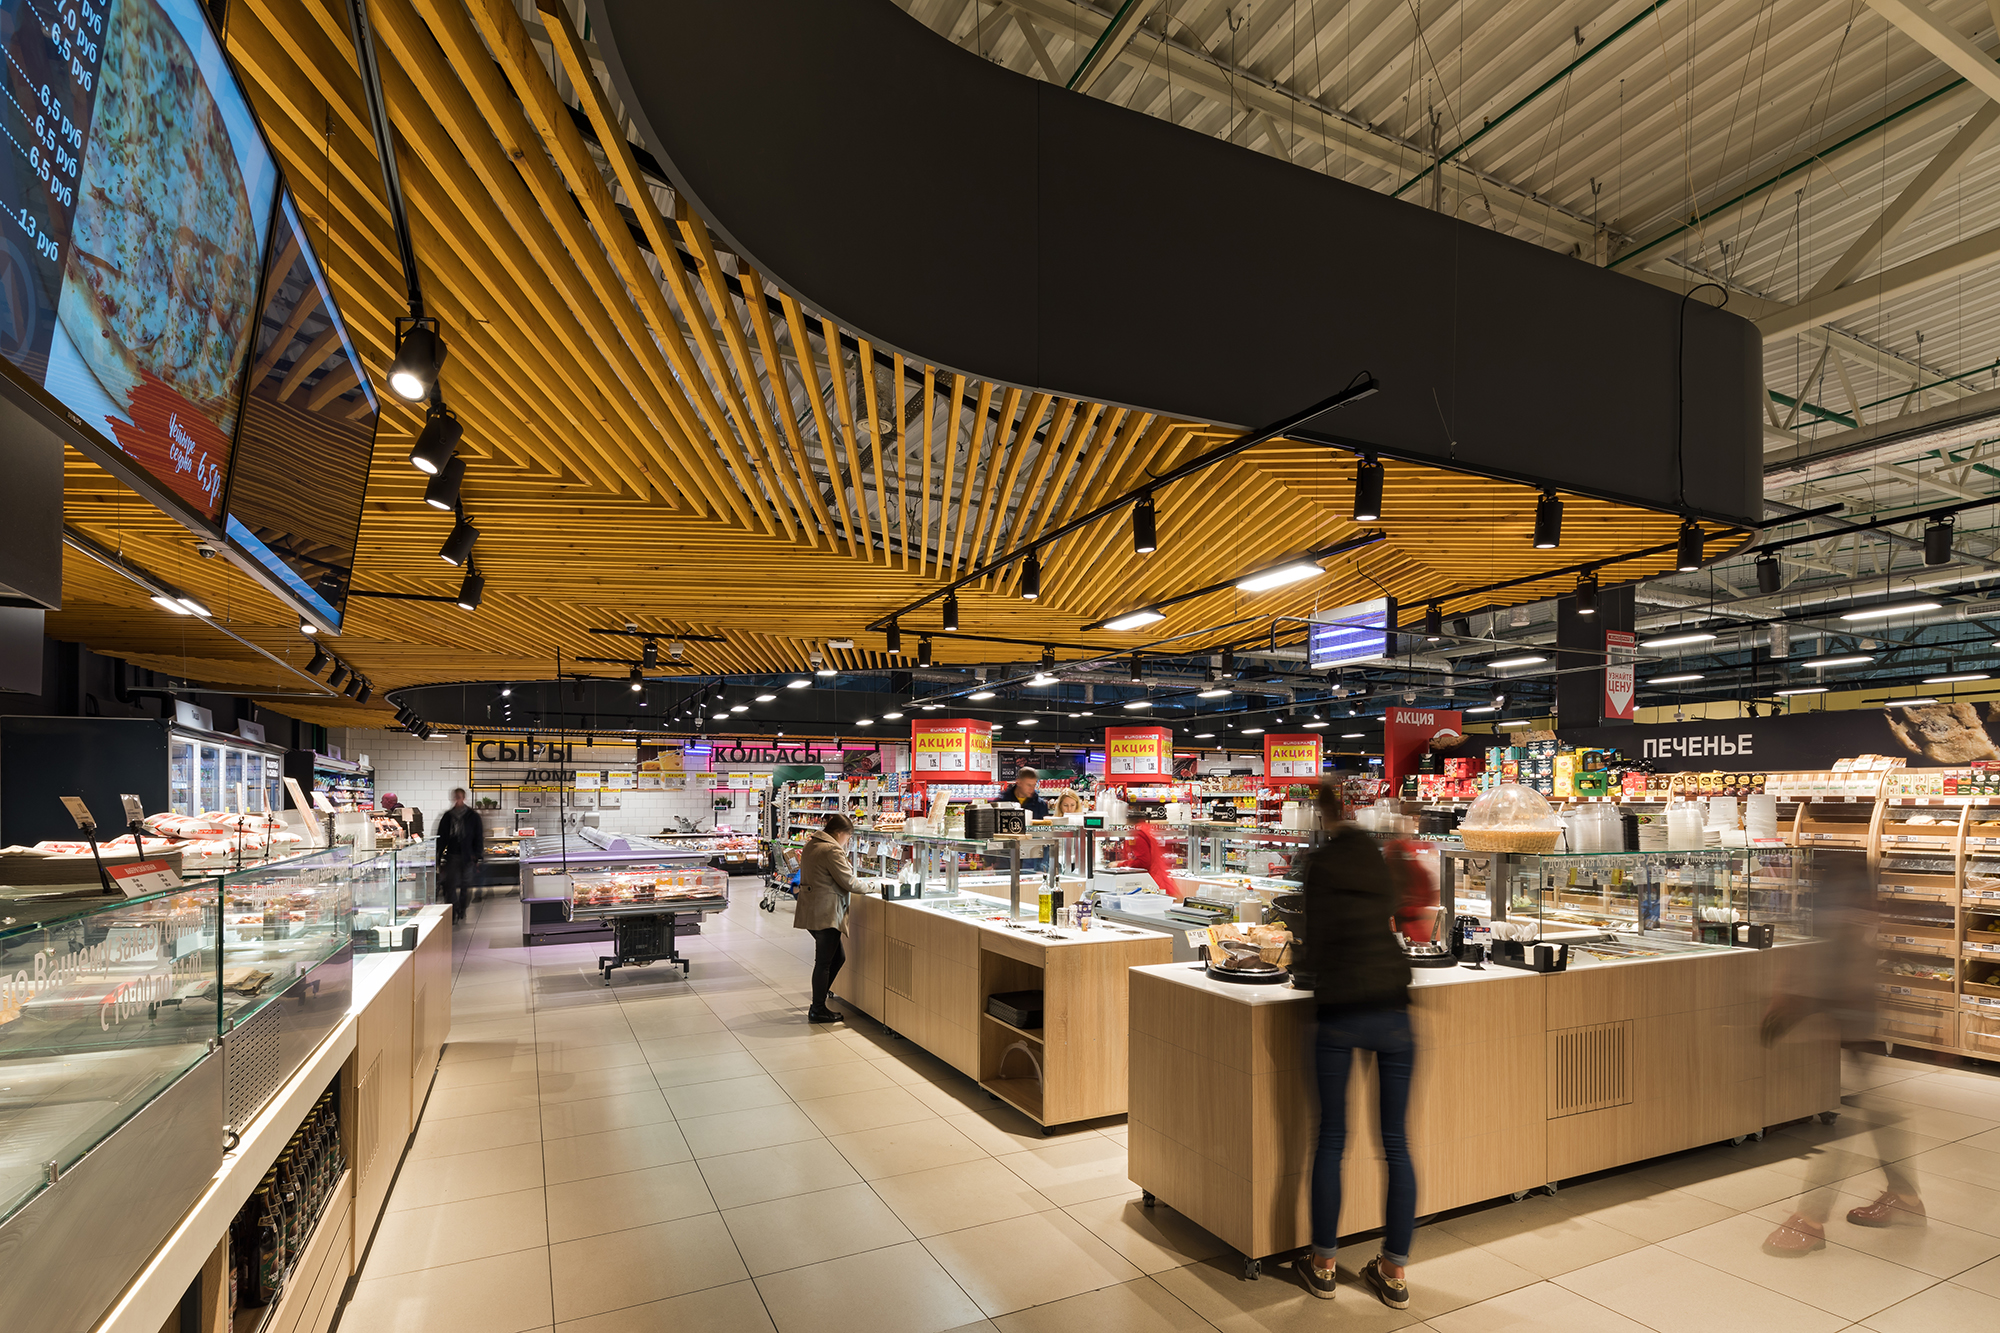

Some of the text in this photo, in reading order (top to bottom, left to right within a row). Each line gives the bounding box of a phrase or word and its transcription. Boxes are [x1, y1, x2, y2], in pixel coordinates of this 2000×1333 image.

[51, 22, 93, 92] 6,5 руб
[76, 27, 98, 64] руб
[40, 84, 83, 150] 6,5 руб
[35, 114, 78, 178] 6,5 руб
[29, 146, 73, 208] 6,5 руб
[18, 208, 60, 262] 13 руб
[1608, 671, 1632, 681] УЗНАЙТЕ
[1608, 680, 1632, 694] ЦЕНУ
[1395, 711, 1435, 727] АКЦИЯ
[476, 739, 573, 763] СЫРЫ
[714, 747, 821, 763] КОЛБАСЫ
[918, 738, 963, 749] АКЦИЯ
[1112, 743, 1155, 754] АКЦИЯ
[1272, 749, 1313, 759] АКЦИЯ
[1643, 733, 1753, 758] ПЕЧЕНЬЕ
[1624, 853, 1668, 867] SPAR
[34, 940, 112, 998] Вашему
[115, 922, 163, 963] заказу
[101, 1002, 110, 1032] с
[115, 973, 151, 1025] 10:00
[153, 973, 170, 1011] до
